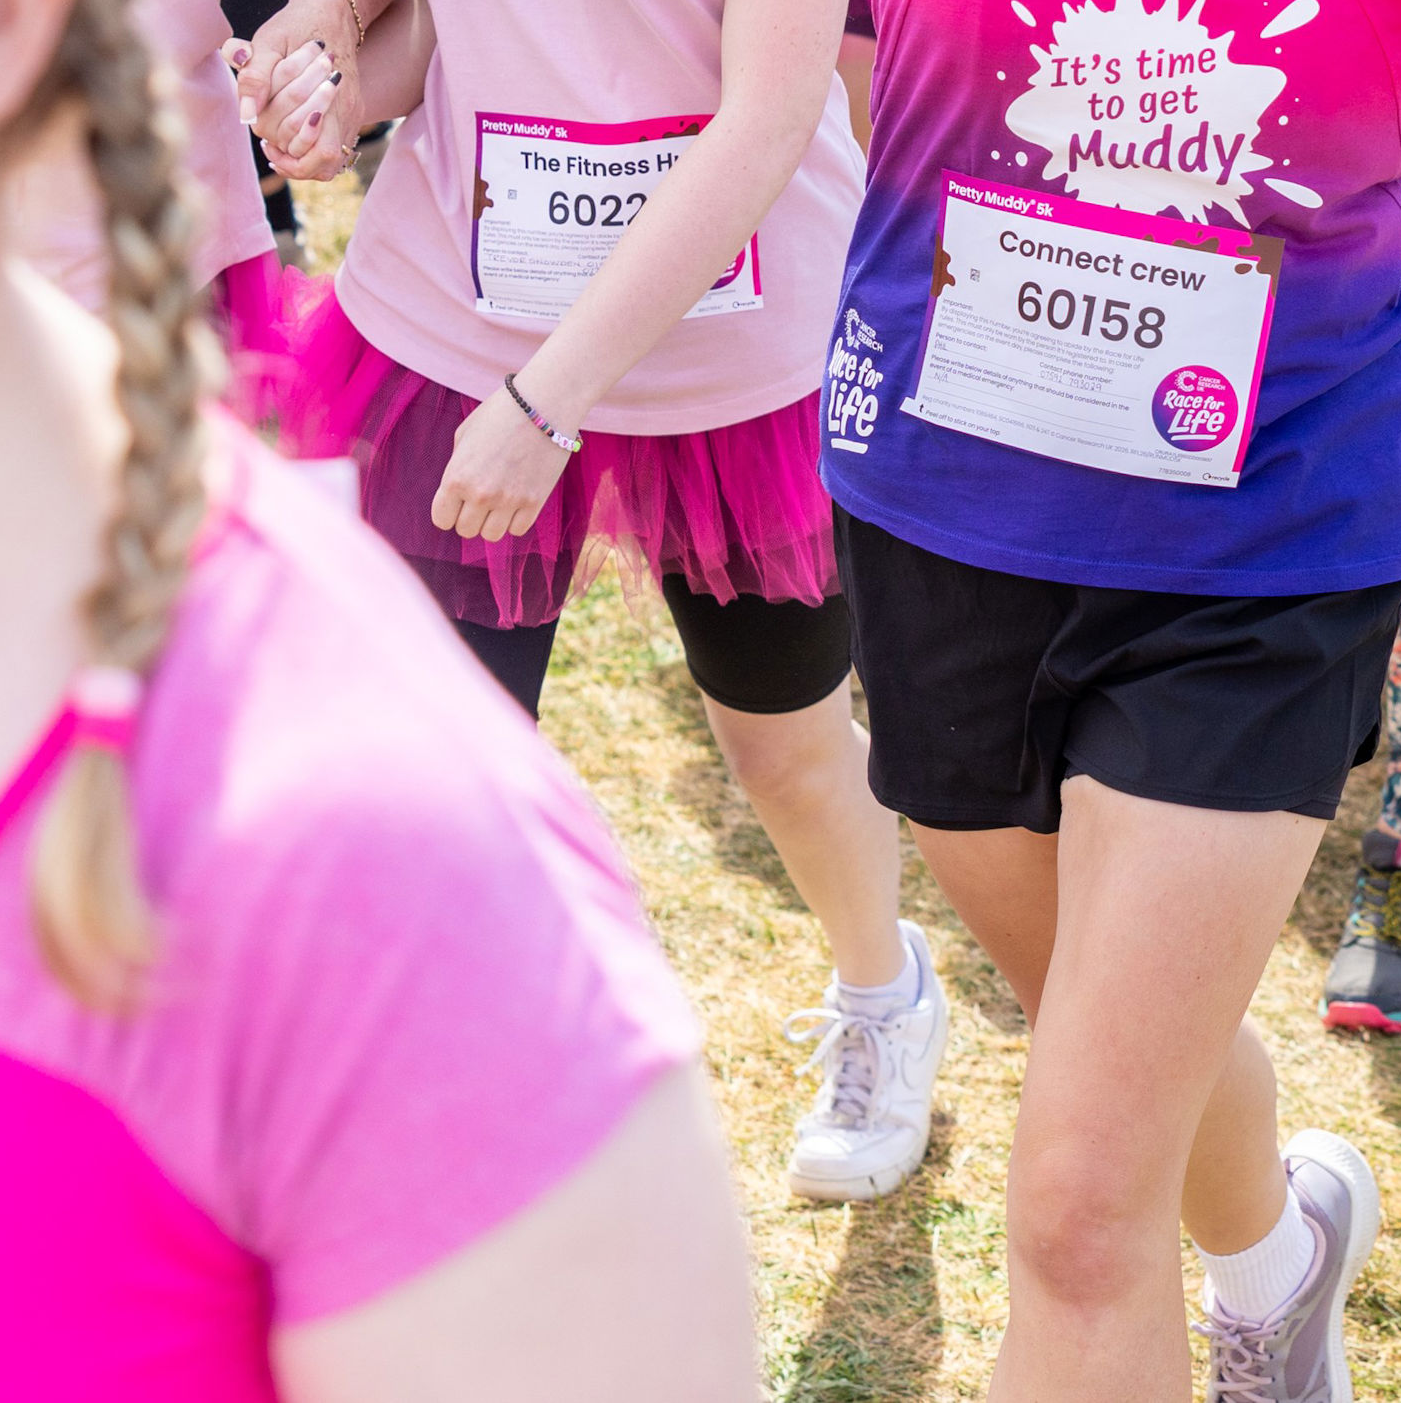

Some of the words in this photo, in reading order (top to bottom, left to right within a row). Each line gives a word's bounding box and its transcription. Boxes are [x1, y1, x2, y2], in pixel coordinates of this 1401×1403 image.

[1051, 54, 1121, 87] It’s
[1137, 48, 1216, 80] time
[1088, 93, 1124, 121] to
[1139, 84, 1198, 123] get
[482, 119, 514, 134] Pretty
[555, 127, 568, 139] 5k
[521, 151, 561, 172] The
[567, 156, 650, 177] Fitness
[657, 153, 679, 173] H
[1069, 121, 1246, 186] Muddy
[549, 190, 648, 227] 6022
[949, 180, 984, 203] Pretty
[1036, 202, 1054, 217] 5k
[999, 230, 1124, 277] Connect
[1130, 262, 1206, 292] crew
[1018, 281, 1166, 349] 60158
[857, 357, 884, 390] for
[828, 379, 879, 437] Life
[1163, 390, 1203, 409] Race
[1203, 396, 1225, 410] for
[1167, 409, 1225, 434] Life
